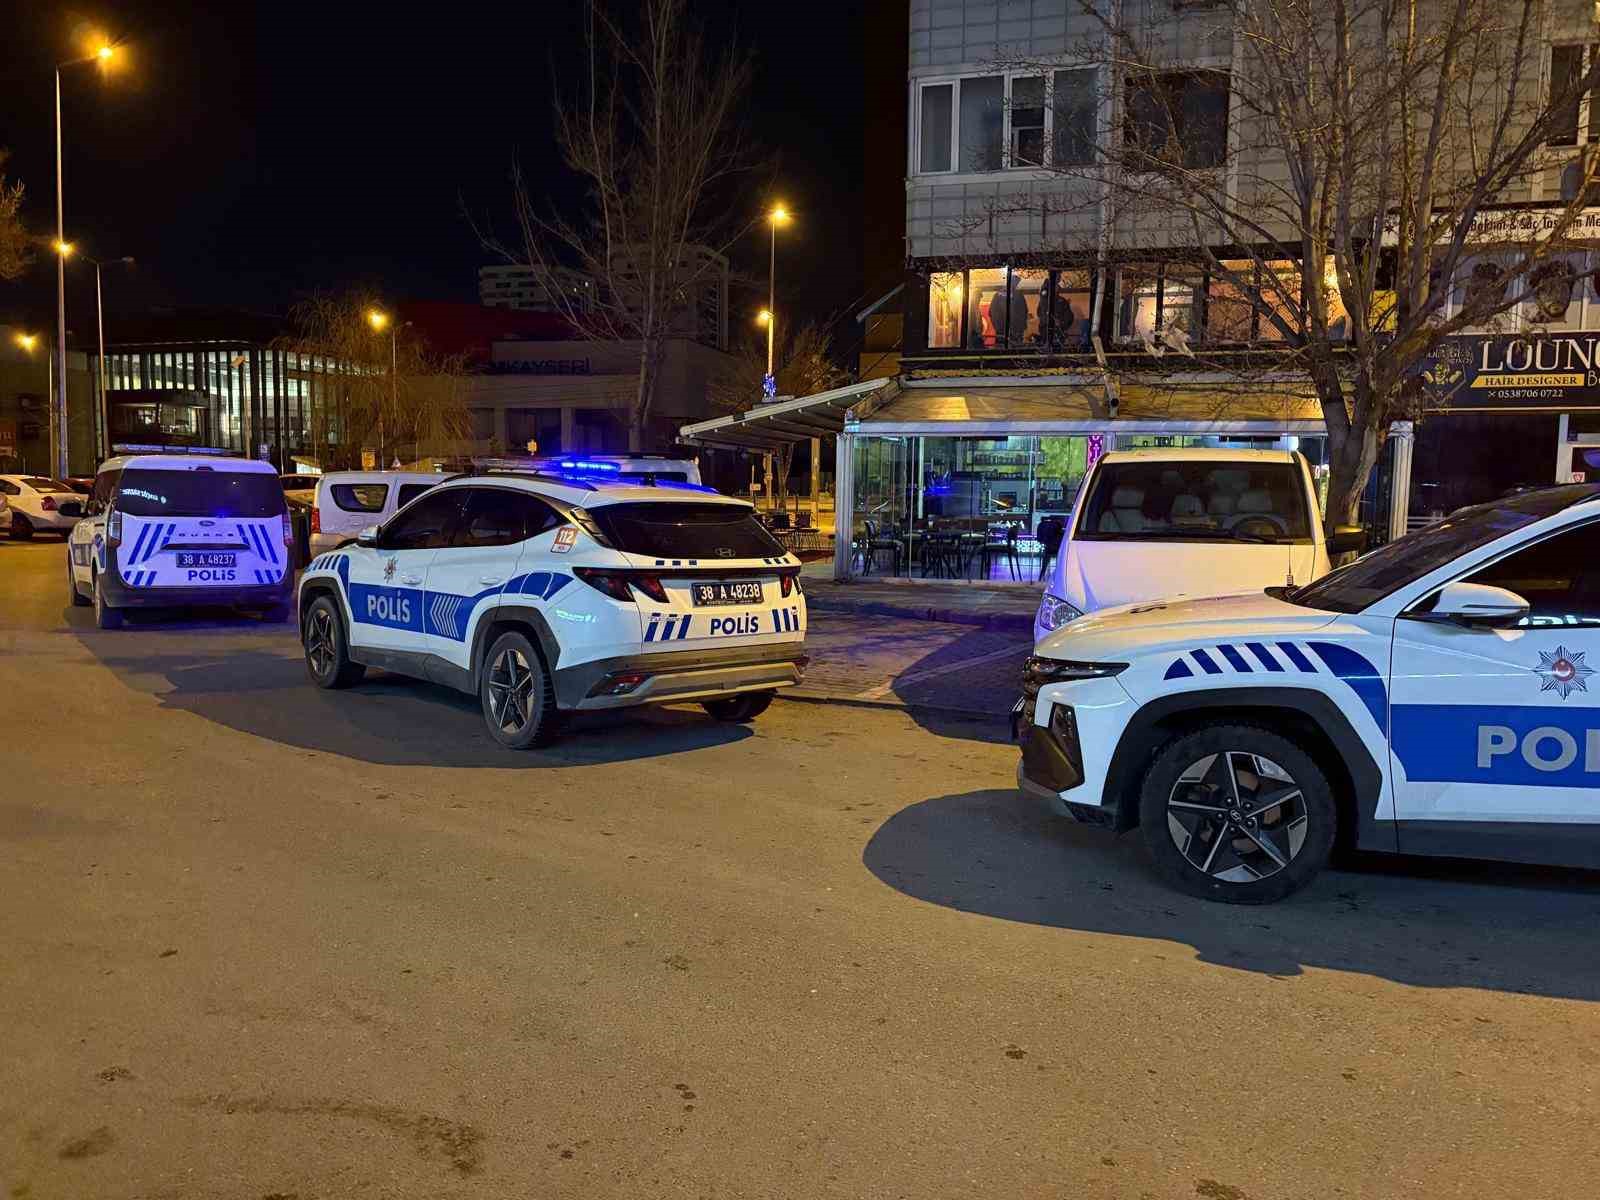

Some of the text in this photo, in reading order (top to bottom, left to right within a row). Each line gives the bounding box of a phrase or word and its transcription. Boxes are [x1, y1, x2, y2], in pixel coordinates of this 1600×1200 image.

[1478, 337, 1600, 372] LOUN
[1498, 389, 1563, 399] 0538706 0722
[559, 530, 575, 544] 112
[183, 554, 234, 566] 38 A 48237
[188, 570, 236, 582] POLİS
[700, 583, 761, 600] 38 A 48238
[367, 589, 411, 623] POLİS
[710, 612, 759, 636] POLİS
